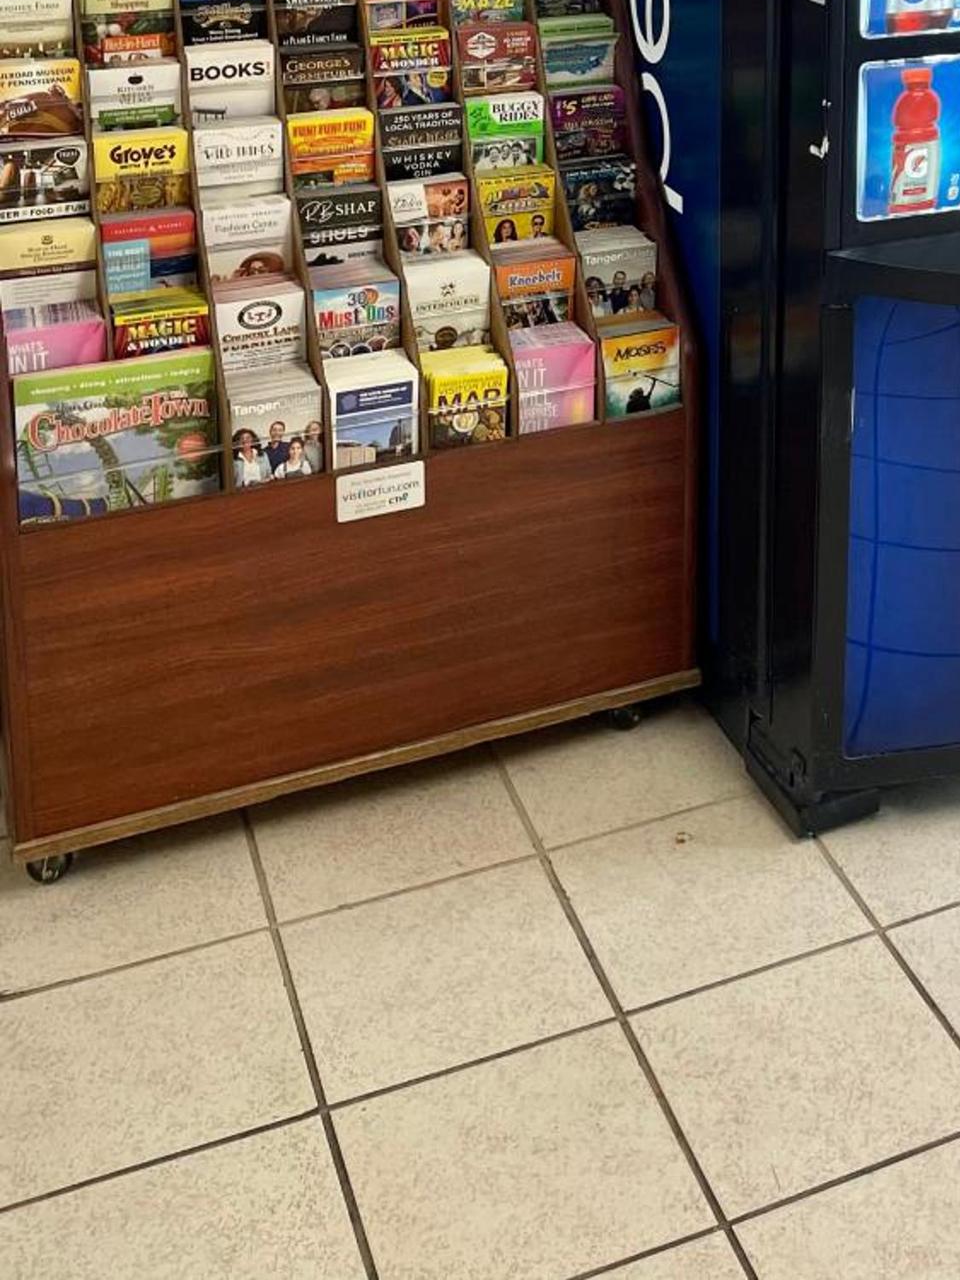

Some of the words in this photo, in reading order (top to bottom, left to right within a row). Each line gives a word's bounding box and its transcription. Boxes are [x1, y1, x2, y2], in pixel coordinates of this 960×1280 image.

[382, 43, 439, 60] MAGIC
[285, 58, 351, 74] GEORGE'S
[389, 56, 440, 68] WONDER
[36, 66, 75, 77] MUSEUM
[7, 75, 72, 88] PENNSYLVANIA
[492, 99, 541, 114] BUGGY
[411, 112, 438, 123] YEARS
[440, 111, 453, 119] OF
[499, 111, 540, 124] RIDES
[385, 122, 414, 132] LOCAL
[415, 119, 461, 130] TRADITION
[109, 143, 177, 162] Grove's
[391, 150, 452, 166] WHISKEY
[404, 161, 440, 171] VODKA
[413, 169, 432, 178] GIN
[65, 202, 86, 212] FUN
[584, 253, 622, 266] Tanger
[508, 270, 561, 288] Knoebels
[318, 307, 362, 329] Must
[127, 319, 196, 341] MAGIC
[222, 329, 270, 344] COUNTRY
[127, 341, 138, 352] &
[139, 334, 196, 350] WONDER
[32, 350, 49, 367] IT
[612, 340, 668, 363] MOSES
[30, 385, 71, 397] shopping
[79, 379, 106, 390] dining
[115, 373, 163, 385] attractions
[170, 366, 201, 378] lodging
[533, 368, 548, 387] IT
[437, 388, 502, 408] MAP
[233, 401, 281, 417] Tanger
[341, 480, 421, 503] visitorfun.com
